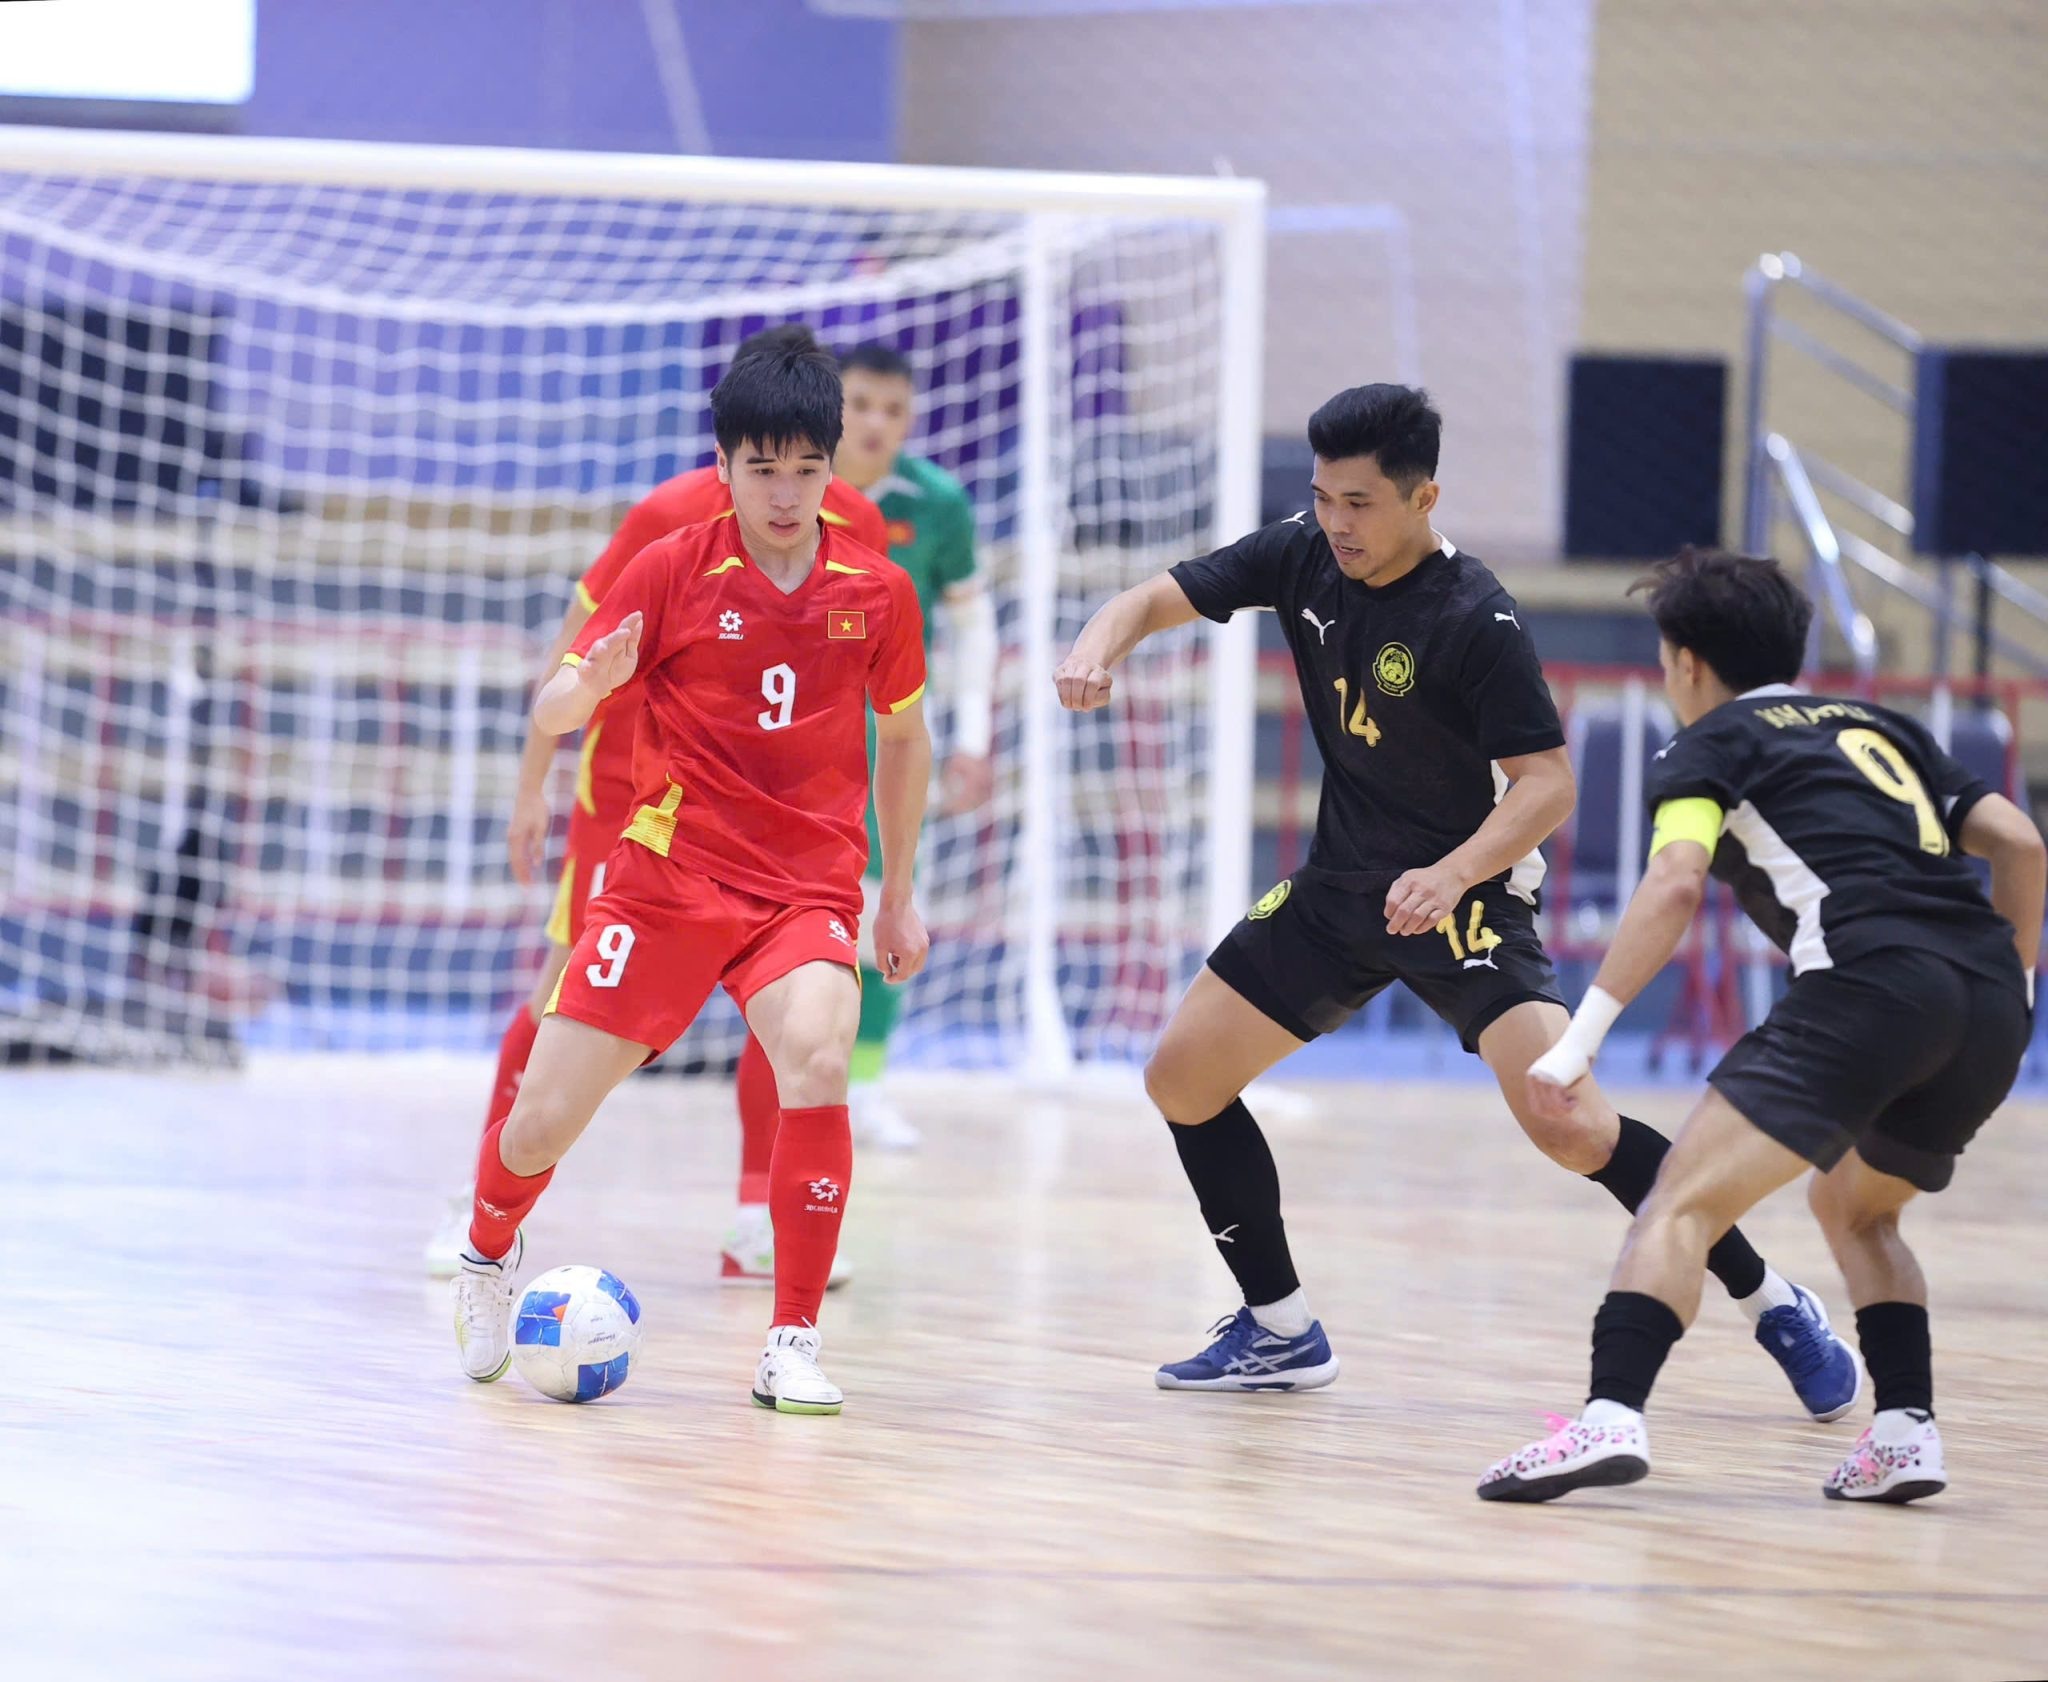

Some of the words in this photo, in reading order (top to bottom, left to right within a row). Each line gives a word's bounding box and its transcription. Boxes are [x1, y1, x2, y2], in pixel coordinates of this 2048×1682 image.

[757, 662, 796, 731] 9
[1333, 677, 1382, 748] 14
[1836, 727, 1950, 858] 9
[585, 924, 636, 987] 9
[1435, 900, 1502, 960] 14
